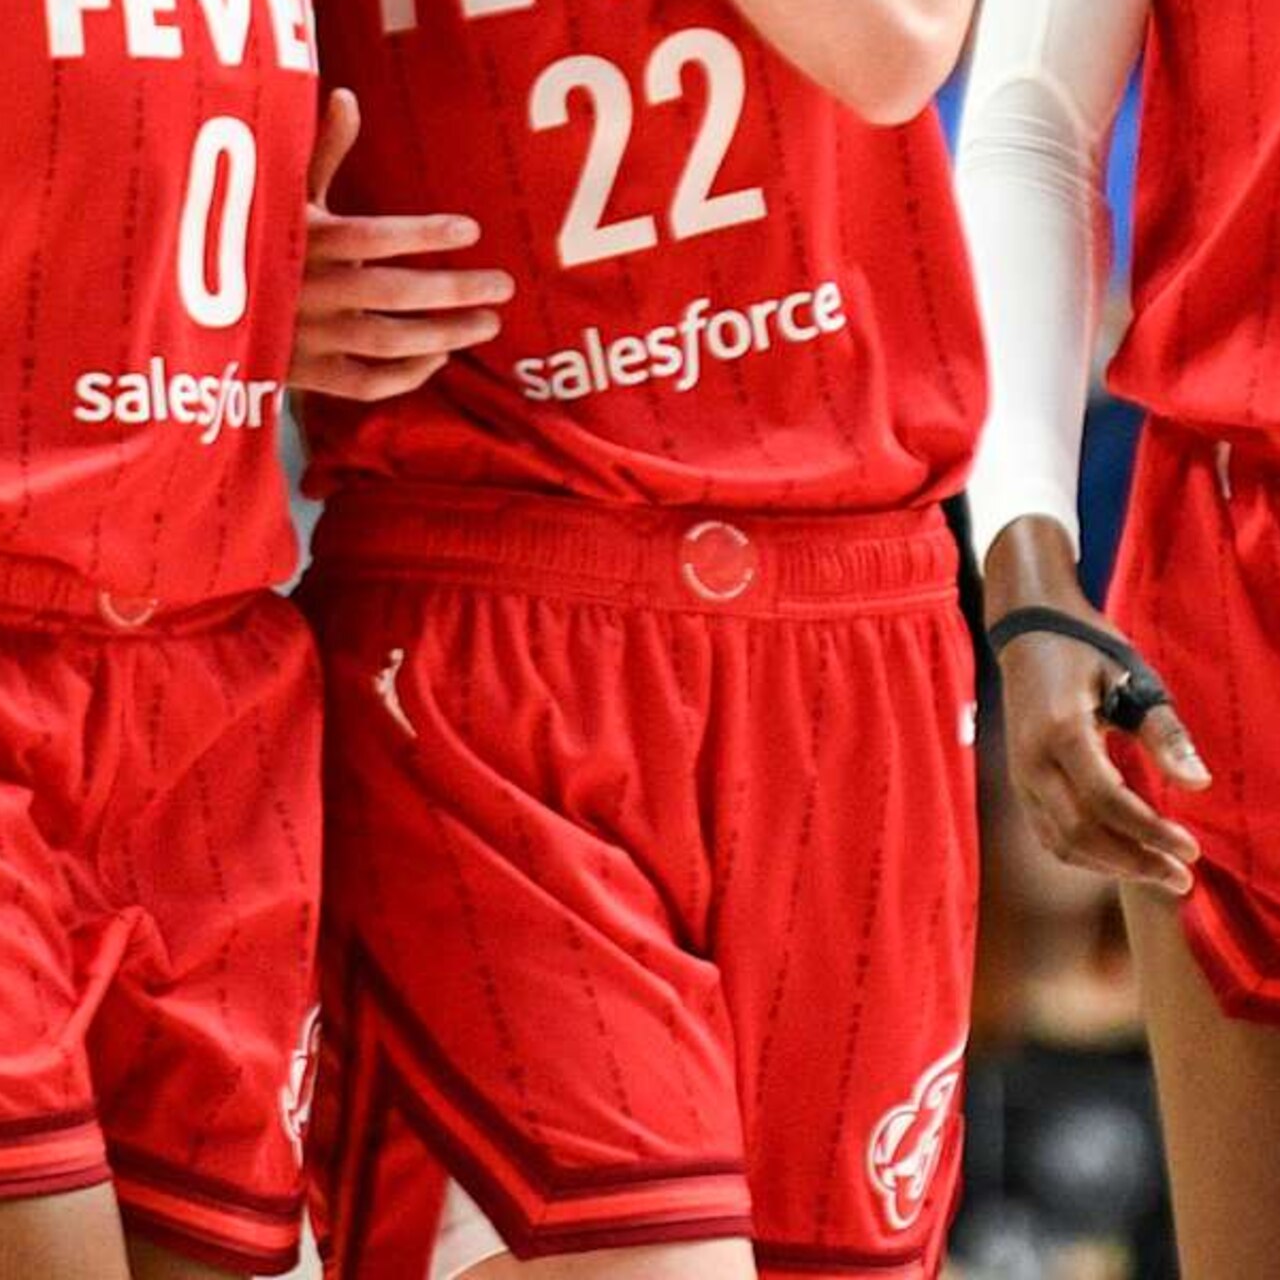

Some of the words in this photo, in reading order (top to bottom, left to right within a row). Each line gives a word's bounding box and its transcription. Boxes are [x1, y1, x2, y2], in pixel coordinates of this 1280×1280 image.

[177, 115, 257, 328] 0
[529, 27, 767, 269] 22
[74, 356, 286, 445] salesfor
[515, 281, 847, 401] salesforce
